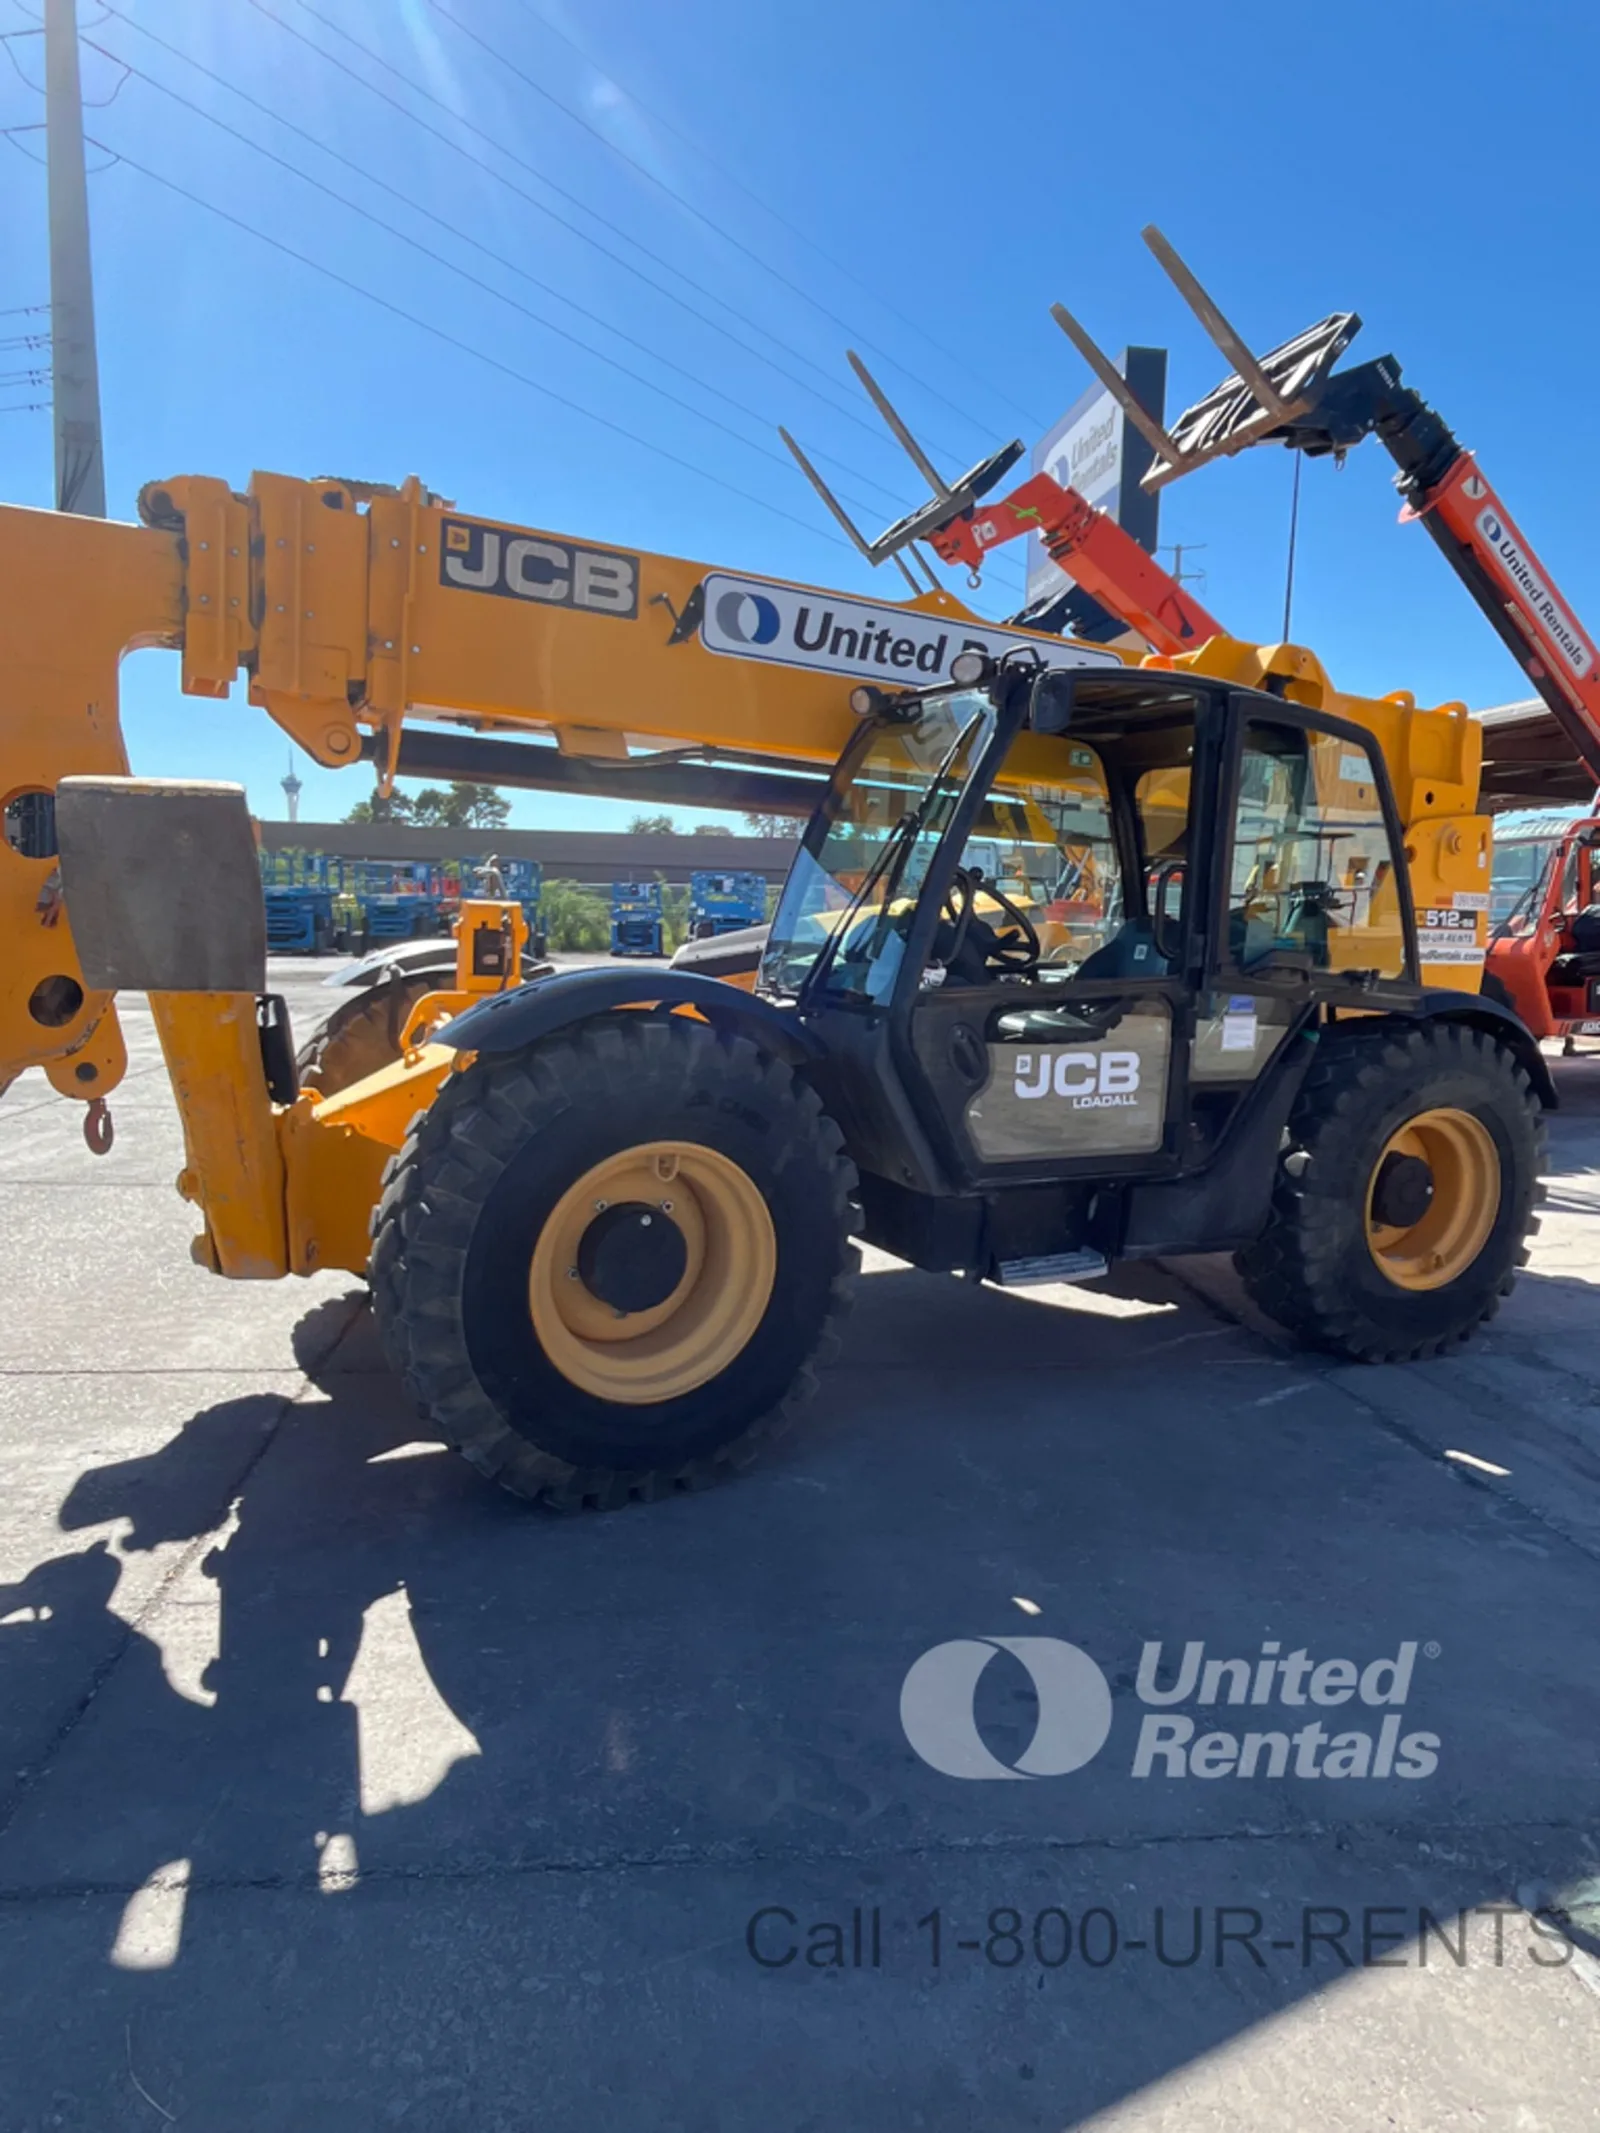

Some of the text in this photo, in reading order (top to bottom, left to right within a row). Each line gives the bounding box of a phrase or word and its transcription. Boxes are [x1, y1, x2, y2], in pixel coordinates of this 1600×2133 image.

[1072, 405, 1117, 469] United
[1072, 442, 1118, 491] Rentals
[445, 526, 635, 613] JCB
[1500, 541, 1584, 666] United Rentals
[793, 606, 948, 673] United
[1014, 1051, 1140, 1099] JCB
[1073, 1094, 1139, 1109] LOADALL
